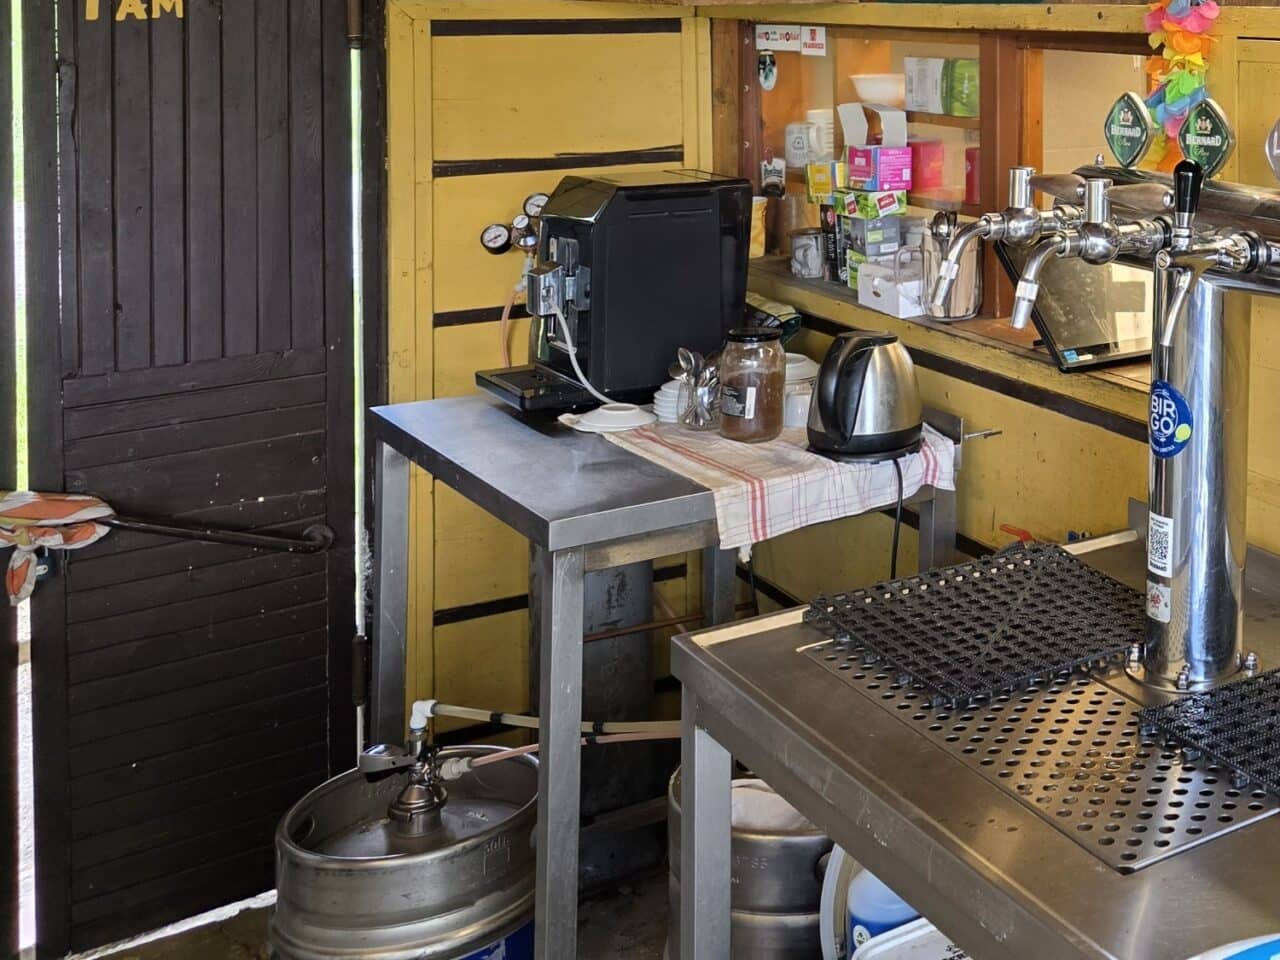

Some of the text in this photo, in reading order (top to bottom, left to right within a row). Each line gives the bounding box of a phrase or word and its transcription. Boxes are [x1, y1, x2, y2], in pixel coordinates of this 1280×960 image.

[1186, 133, 1221, 146] BERNARD
[1152, 395, 1175, 417] BIR
[1151, 413, 1173, 434] GO
